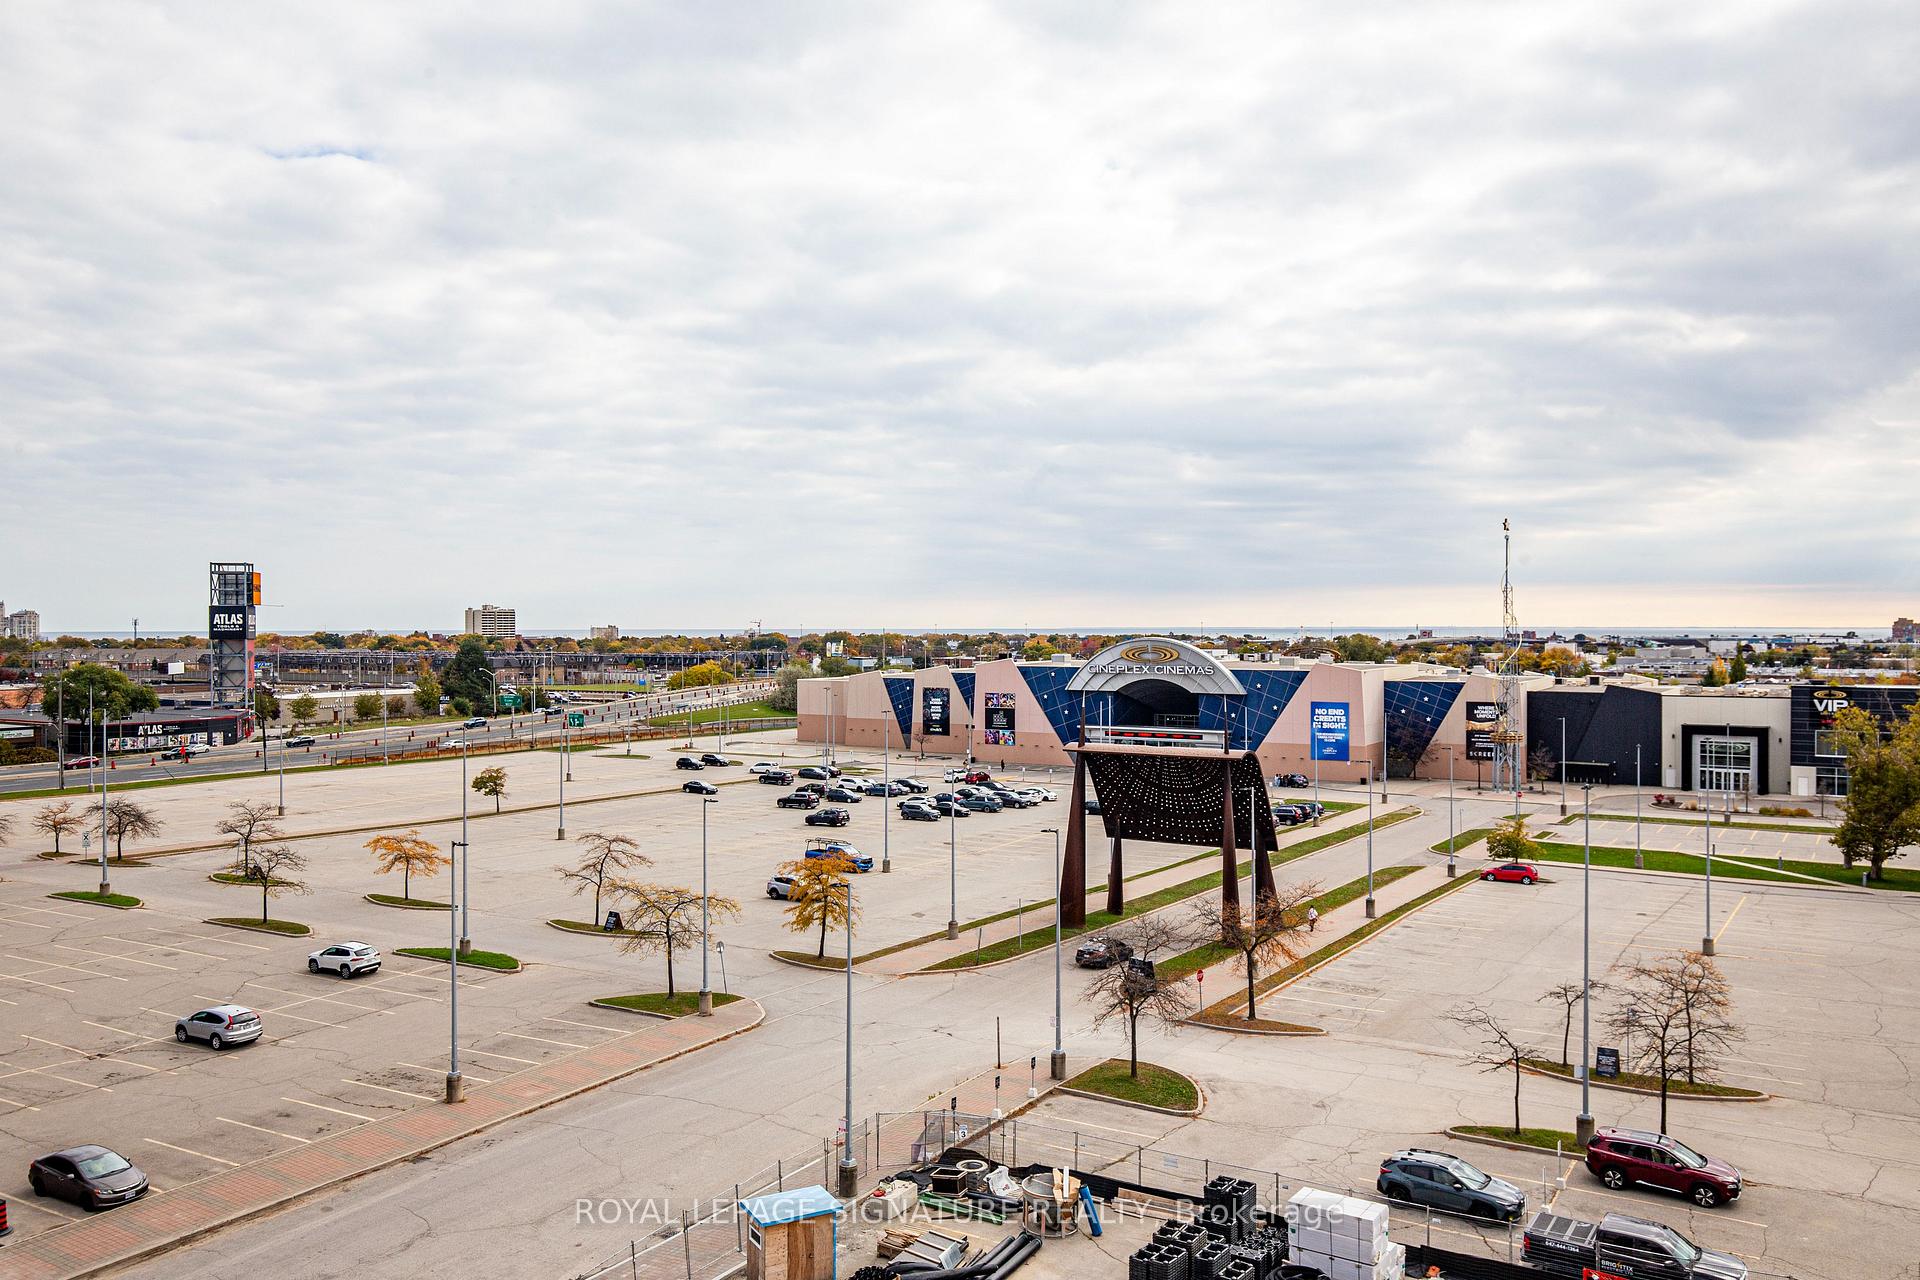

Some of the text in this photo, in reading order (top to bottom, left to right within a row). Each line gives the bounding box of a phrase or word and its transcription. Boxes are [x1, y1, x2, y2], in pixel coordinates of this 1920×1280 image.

[213, 613, 243, 625] ATLAS
[1087, 664, 1214, 675] CINEPLEX CINEMAS
[1813, 699, 1849, 712] VIP
[961, 1130, 966, 1138] 3
